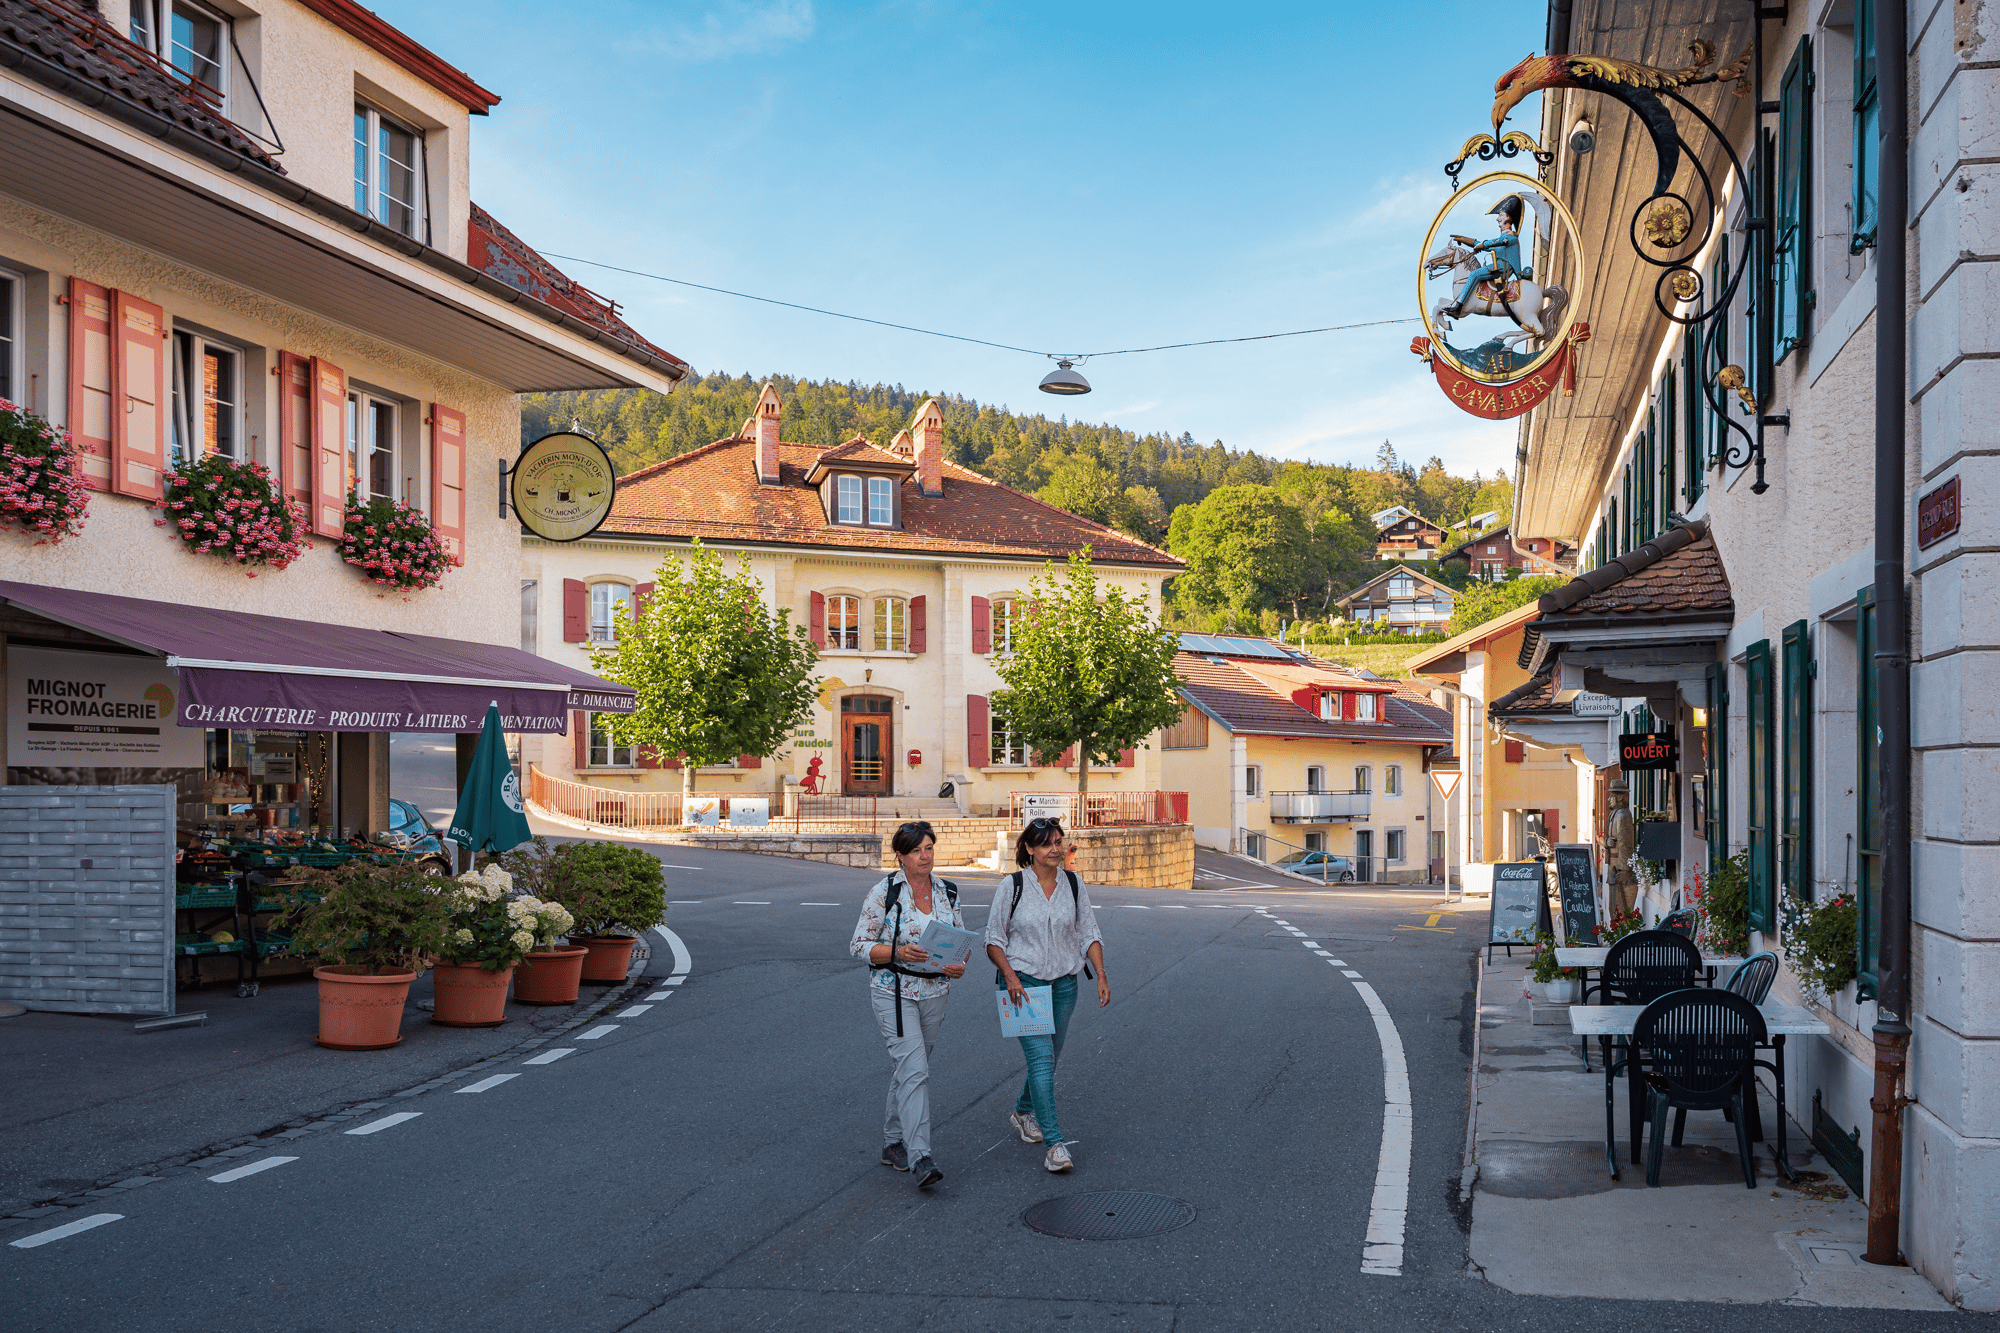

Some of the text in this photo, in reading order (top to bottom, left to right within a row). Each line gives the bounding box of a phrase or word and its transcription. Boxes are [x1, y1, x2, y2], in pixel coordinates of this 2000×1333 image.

[1484, 352, 1513, 374] AU
[1452, 374, 1551, 412] CAVALIER
[526, 453, 560, 478] VACHERIN
[556, 507, 581, 517] MIGNOT
[27, 678, 106, 699] MIGNOT
[566, 692, 633, 709] LE DIMANCHE
[1578, 703, 1615, 711] Livraisons
[27, 698, 156, 719] FROMAGERIE
[185, 703, 564, 729] CHARCUTERIE PRODUITS LAITIERS AMENTATION
[796, 716, 815, 726] arc
[793, 728, 815, 737] Jura
[793, 738, 833, 748] vaudois
[1623, 745, 1671, 759] OUVERT
[1029, 809, 1046, 817] Rolle
[1500, 867, 1535, 879] Coca-Cola
[1565, 898, 1594, 914] Cavalier
